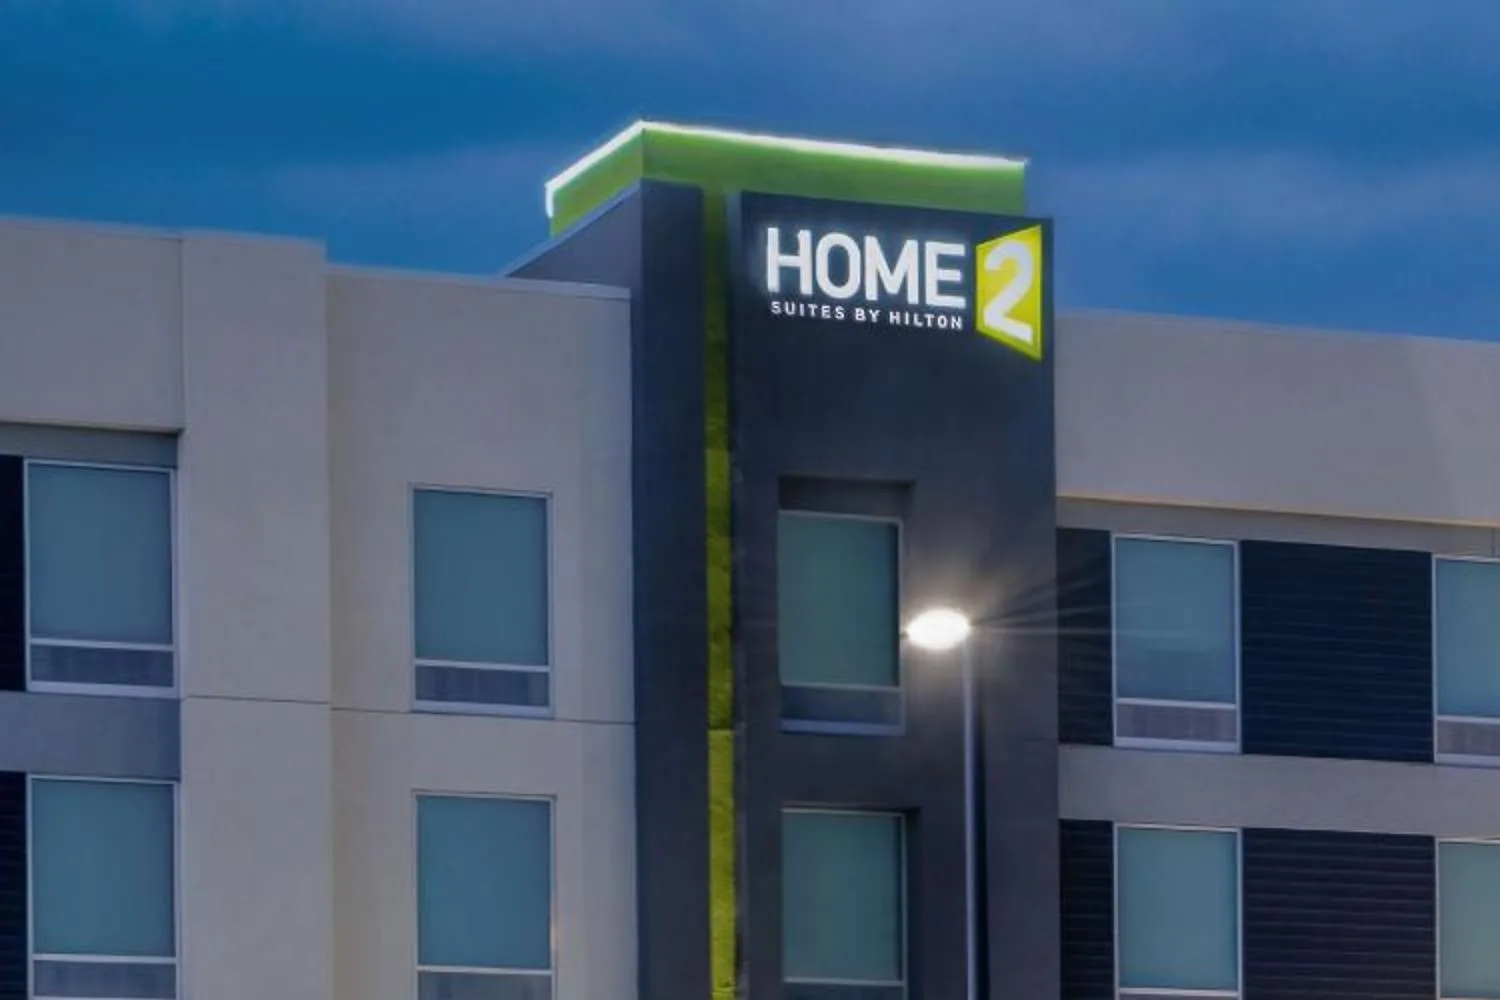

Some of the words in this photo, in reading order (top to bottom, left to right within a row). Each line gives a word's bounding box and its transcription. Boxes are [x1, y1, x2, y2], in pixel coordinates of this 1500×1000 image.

[767, 227, 966, 309] HOME
[984, 240, 1034, 345] 2
[771, 301, 845, 319] SUITES
[855, 309, 880, 323] BY
[889, 311, 963, 330] HILTON
